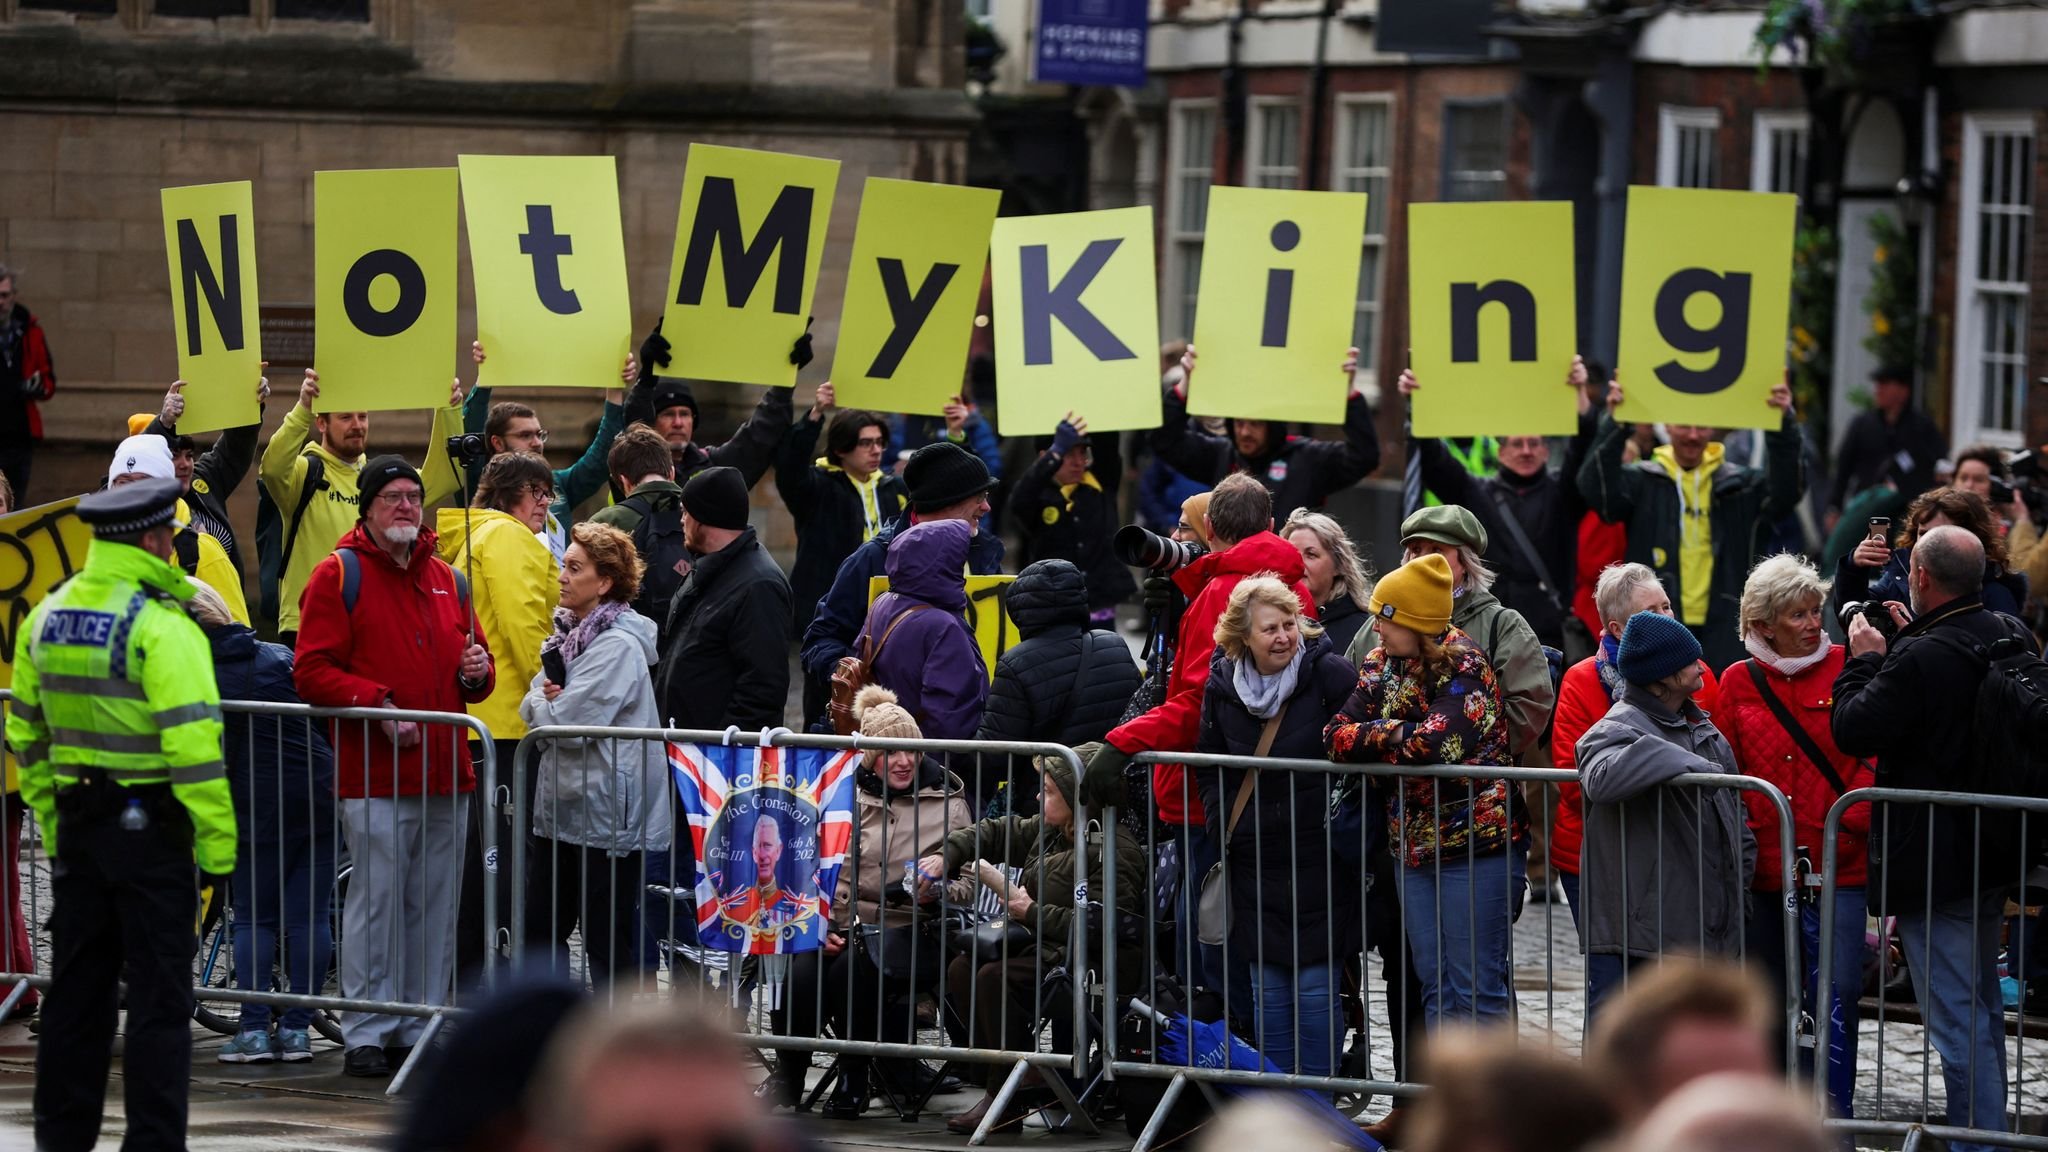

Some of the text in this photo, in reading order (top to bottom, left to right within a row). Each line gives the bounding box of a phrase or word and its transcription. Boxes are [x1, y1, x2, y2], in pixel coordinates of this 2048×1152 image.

[1043, 24, 1141, 45] HOPKINS
[45, 613, 111, 643] POLICE
[724, 802, 749, 822] The
[788, 836, 804, 849] 6th
